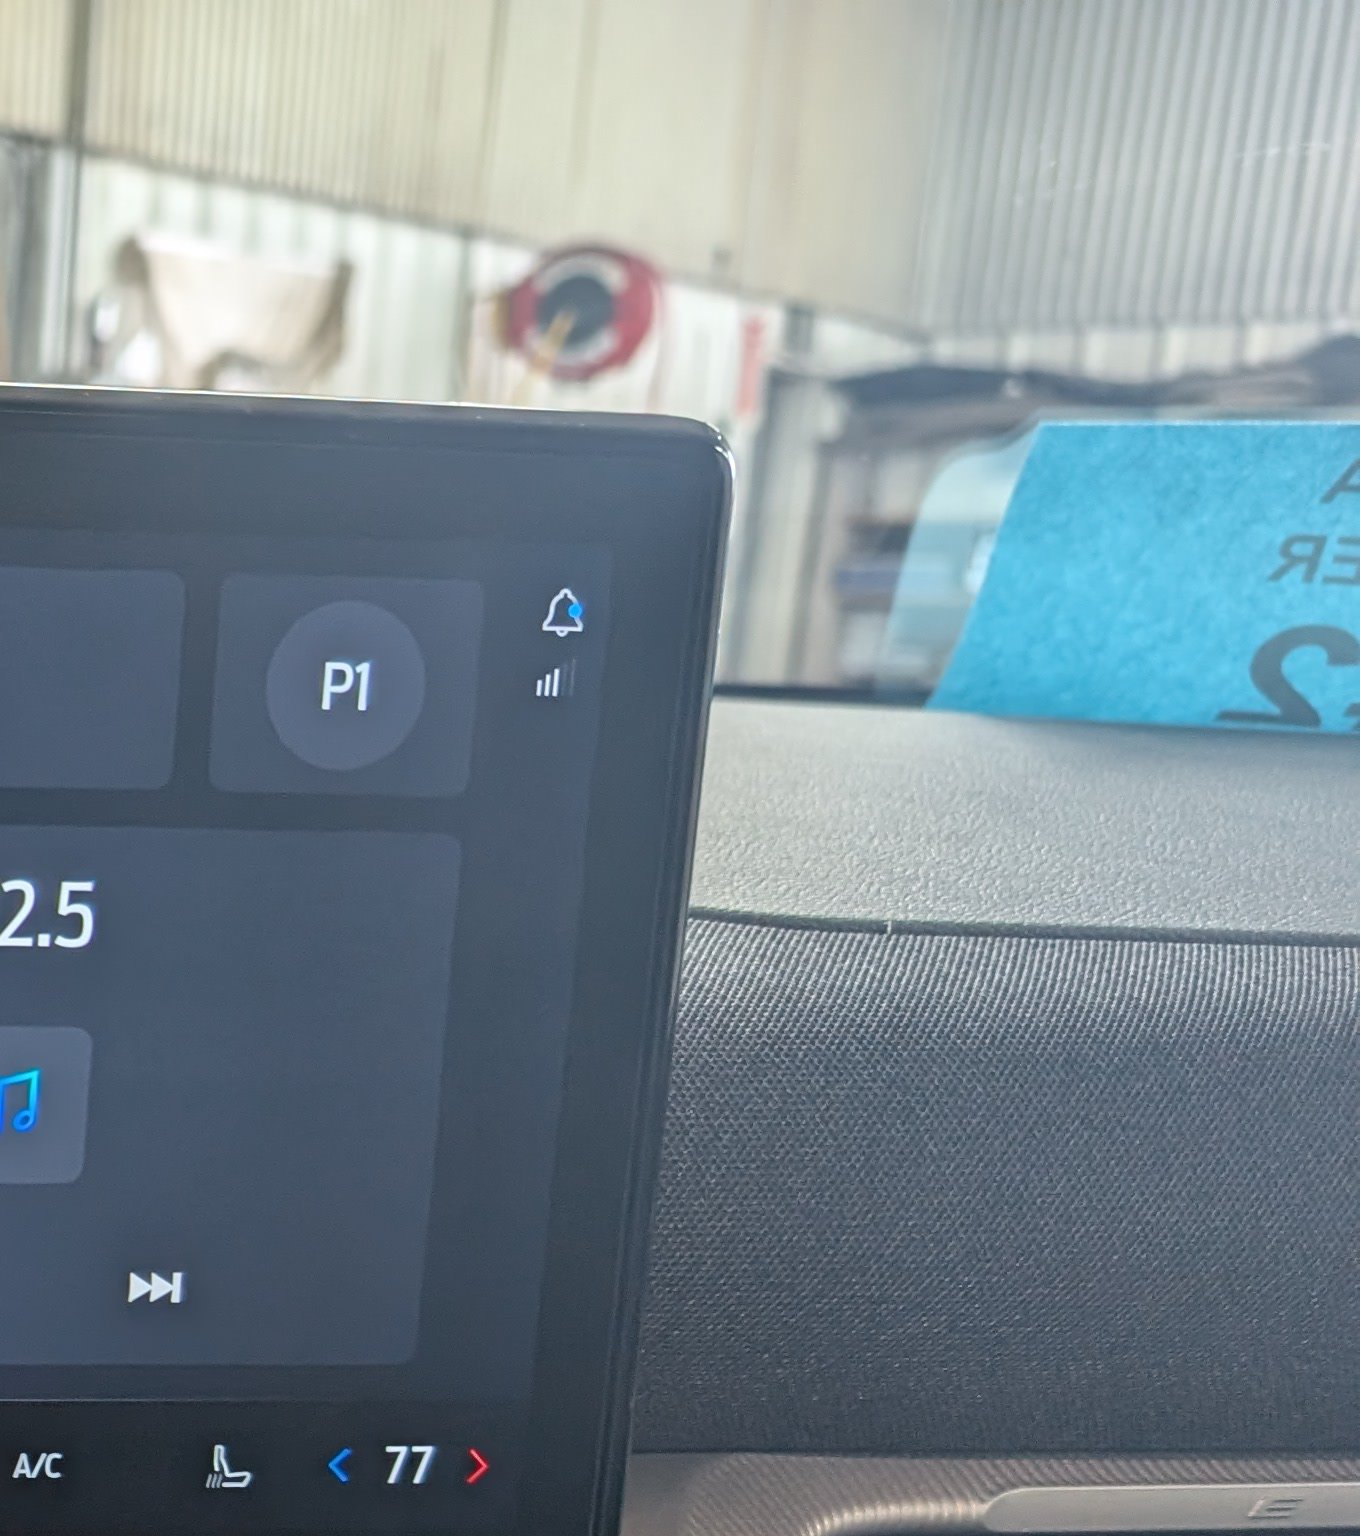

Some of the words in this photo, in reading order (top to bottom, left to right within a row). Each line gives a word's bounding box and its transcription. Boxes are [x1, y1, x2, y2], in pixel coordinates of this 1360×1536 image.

[321, 661, 372, 711] P1
[12, 1452, 64, 1479] A/C
[385, 1445, 435, 1485] 77
